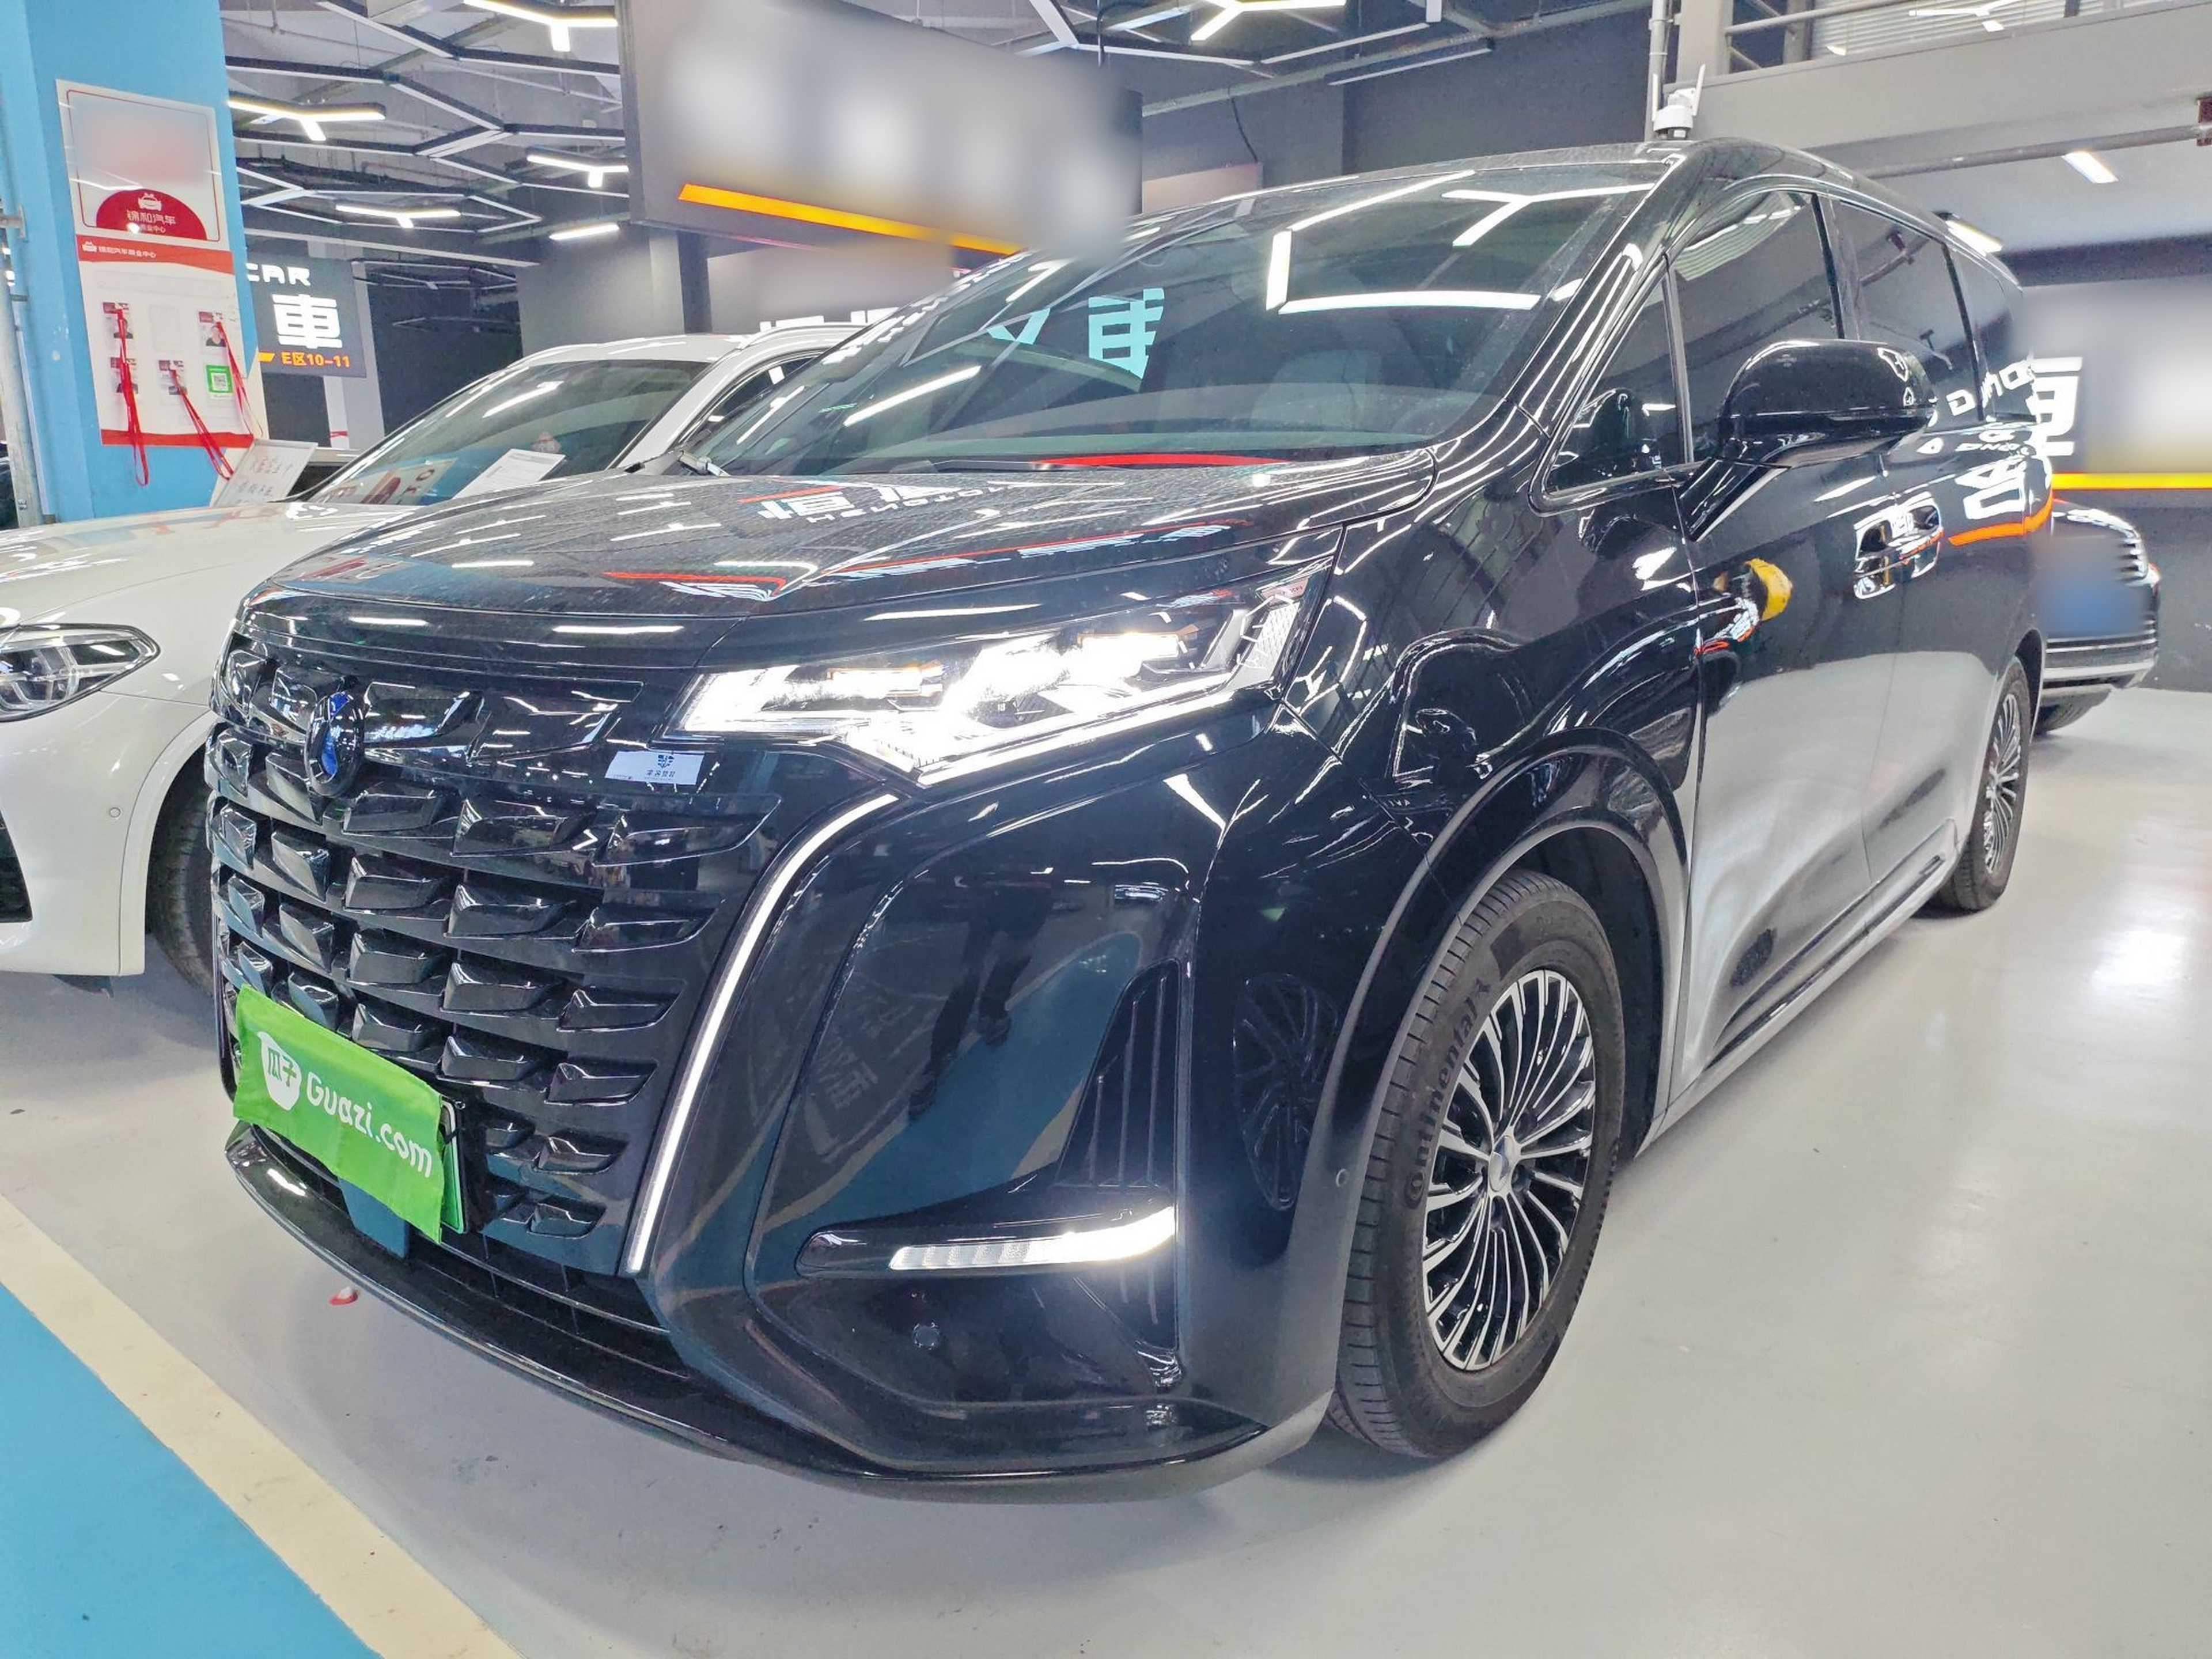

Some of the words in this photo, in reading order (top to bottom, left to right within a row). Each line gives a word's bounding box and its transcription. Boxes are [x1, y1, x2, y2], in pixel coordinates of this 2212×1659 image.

[272, 294, 343, 349] 車
[267, 1048, 297, 1088] 瓜子
[306, 1071, 433, 1179] Guazi.com
